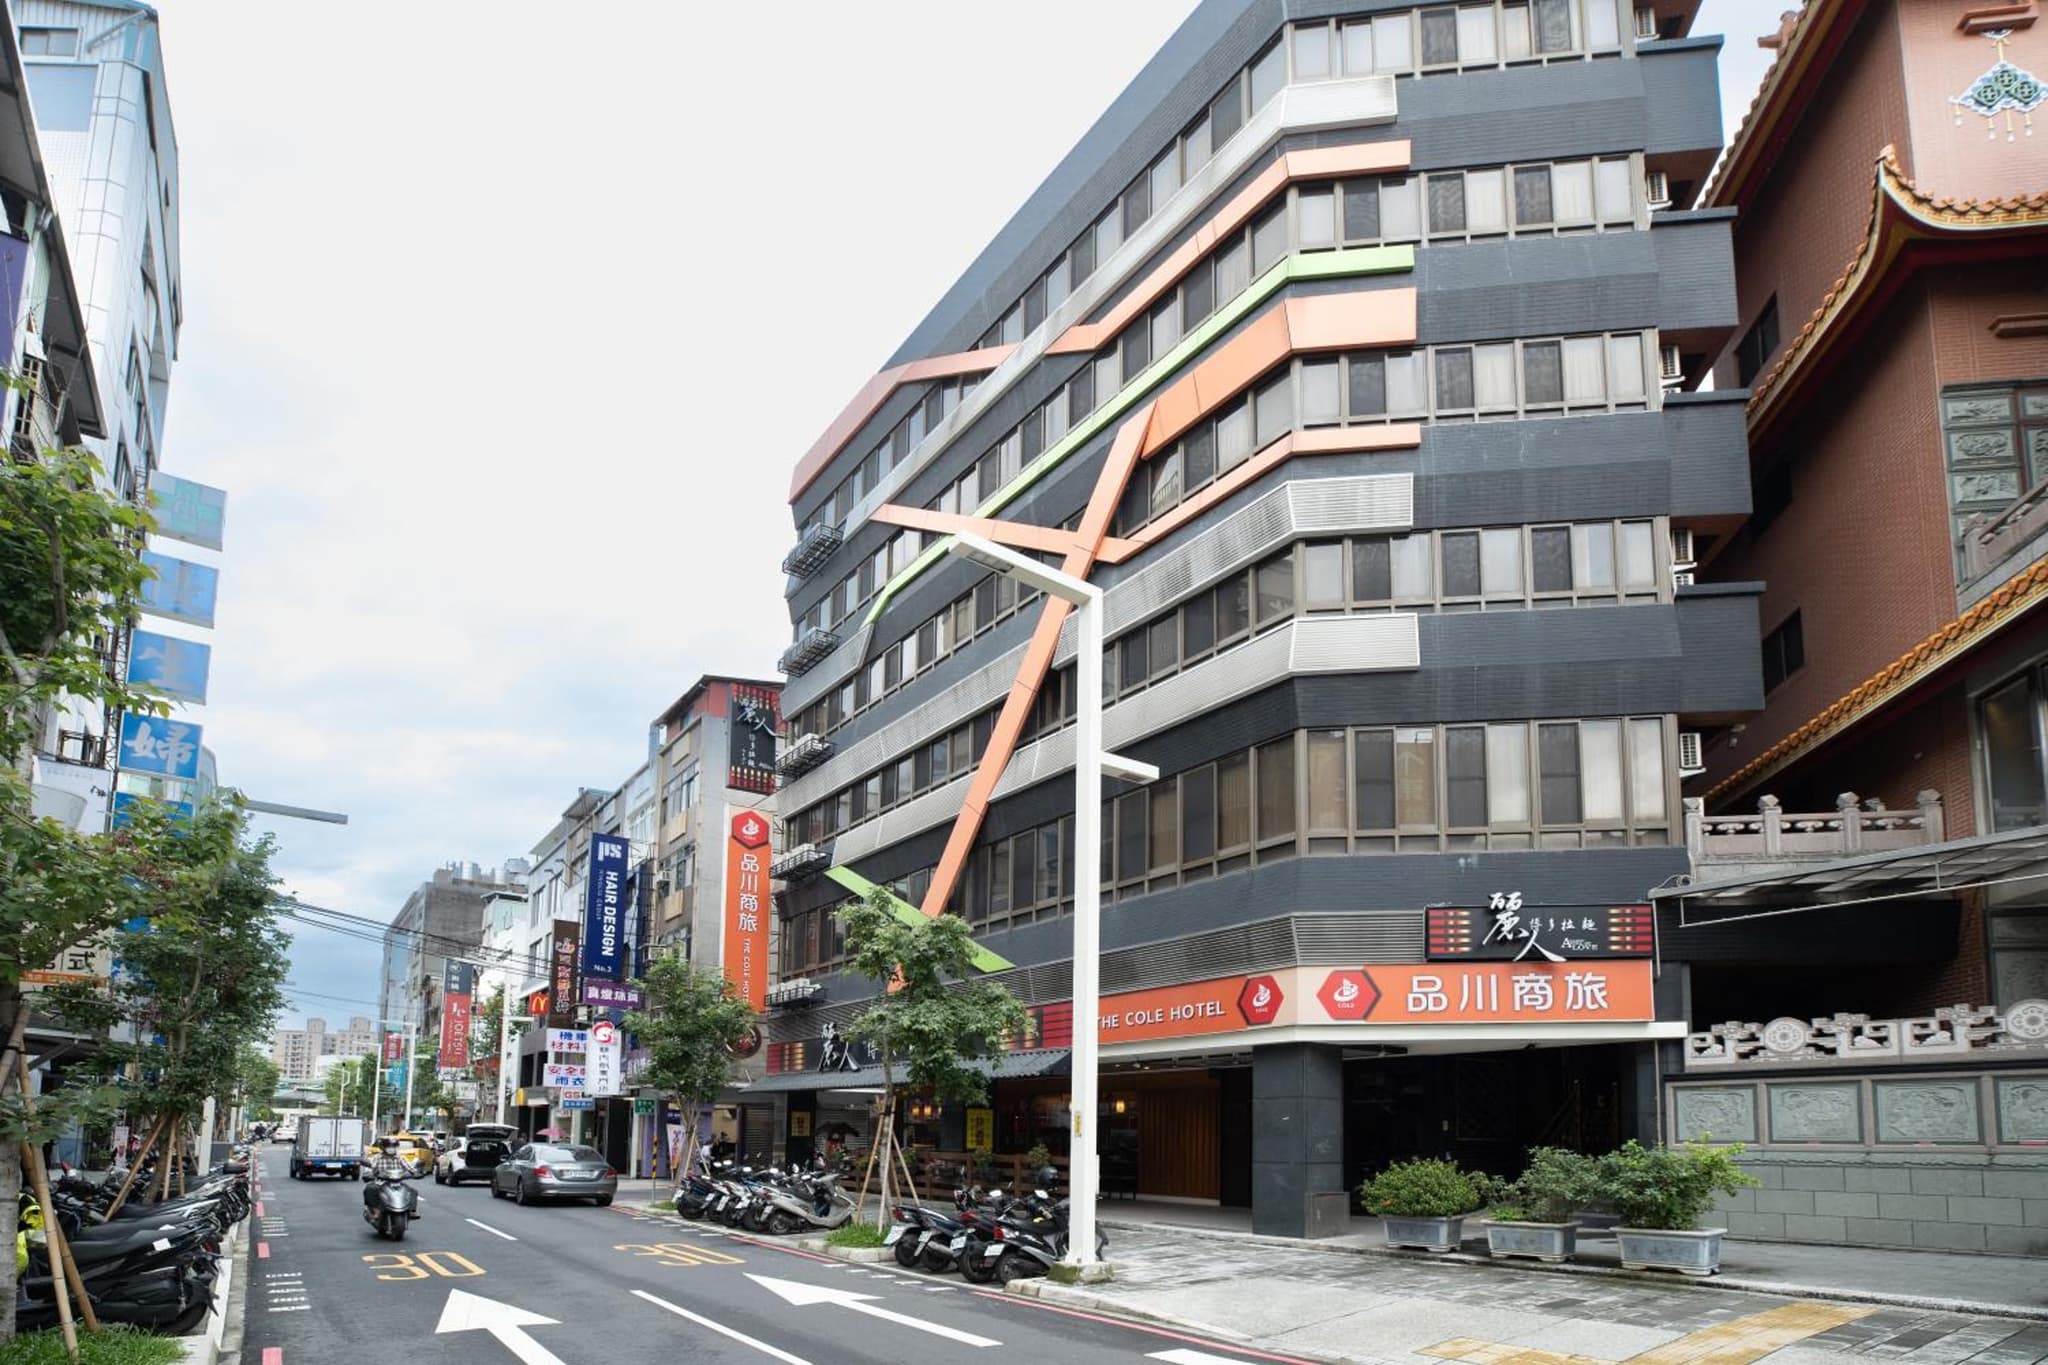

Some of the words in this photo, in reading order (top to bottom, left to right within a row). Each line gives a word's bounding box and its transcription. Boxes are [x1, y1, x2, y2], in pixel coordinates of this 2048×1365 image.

[604, 870, 619, 904] HAIR
[738, 853, 759, 932] 品川商旅
[601, 906, 617, 957] DESIGN
[1482, 892, 1568, 962] 麗人
[743, 956, 751, 977] COLE
[1407, 972, 1609, 1012] 品川商旅
[1125, 1008, 1164, 1026] COLE
[1170, 1000, 1226, 1021] HOTEL
[361, 1252, 488, 1281] 30
[614, 1242, 748, 1266] 30
